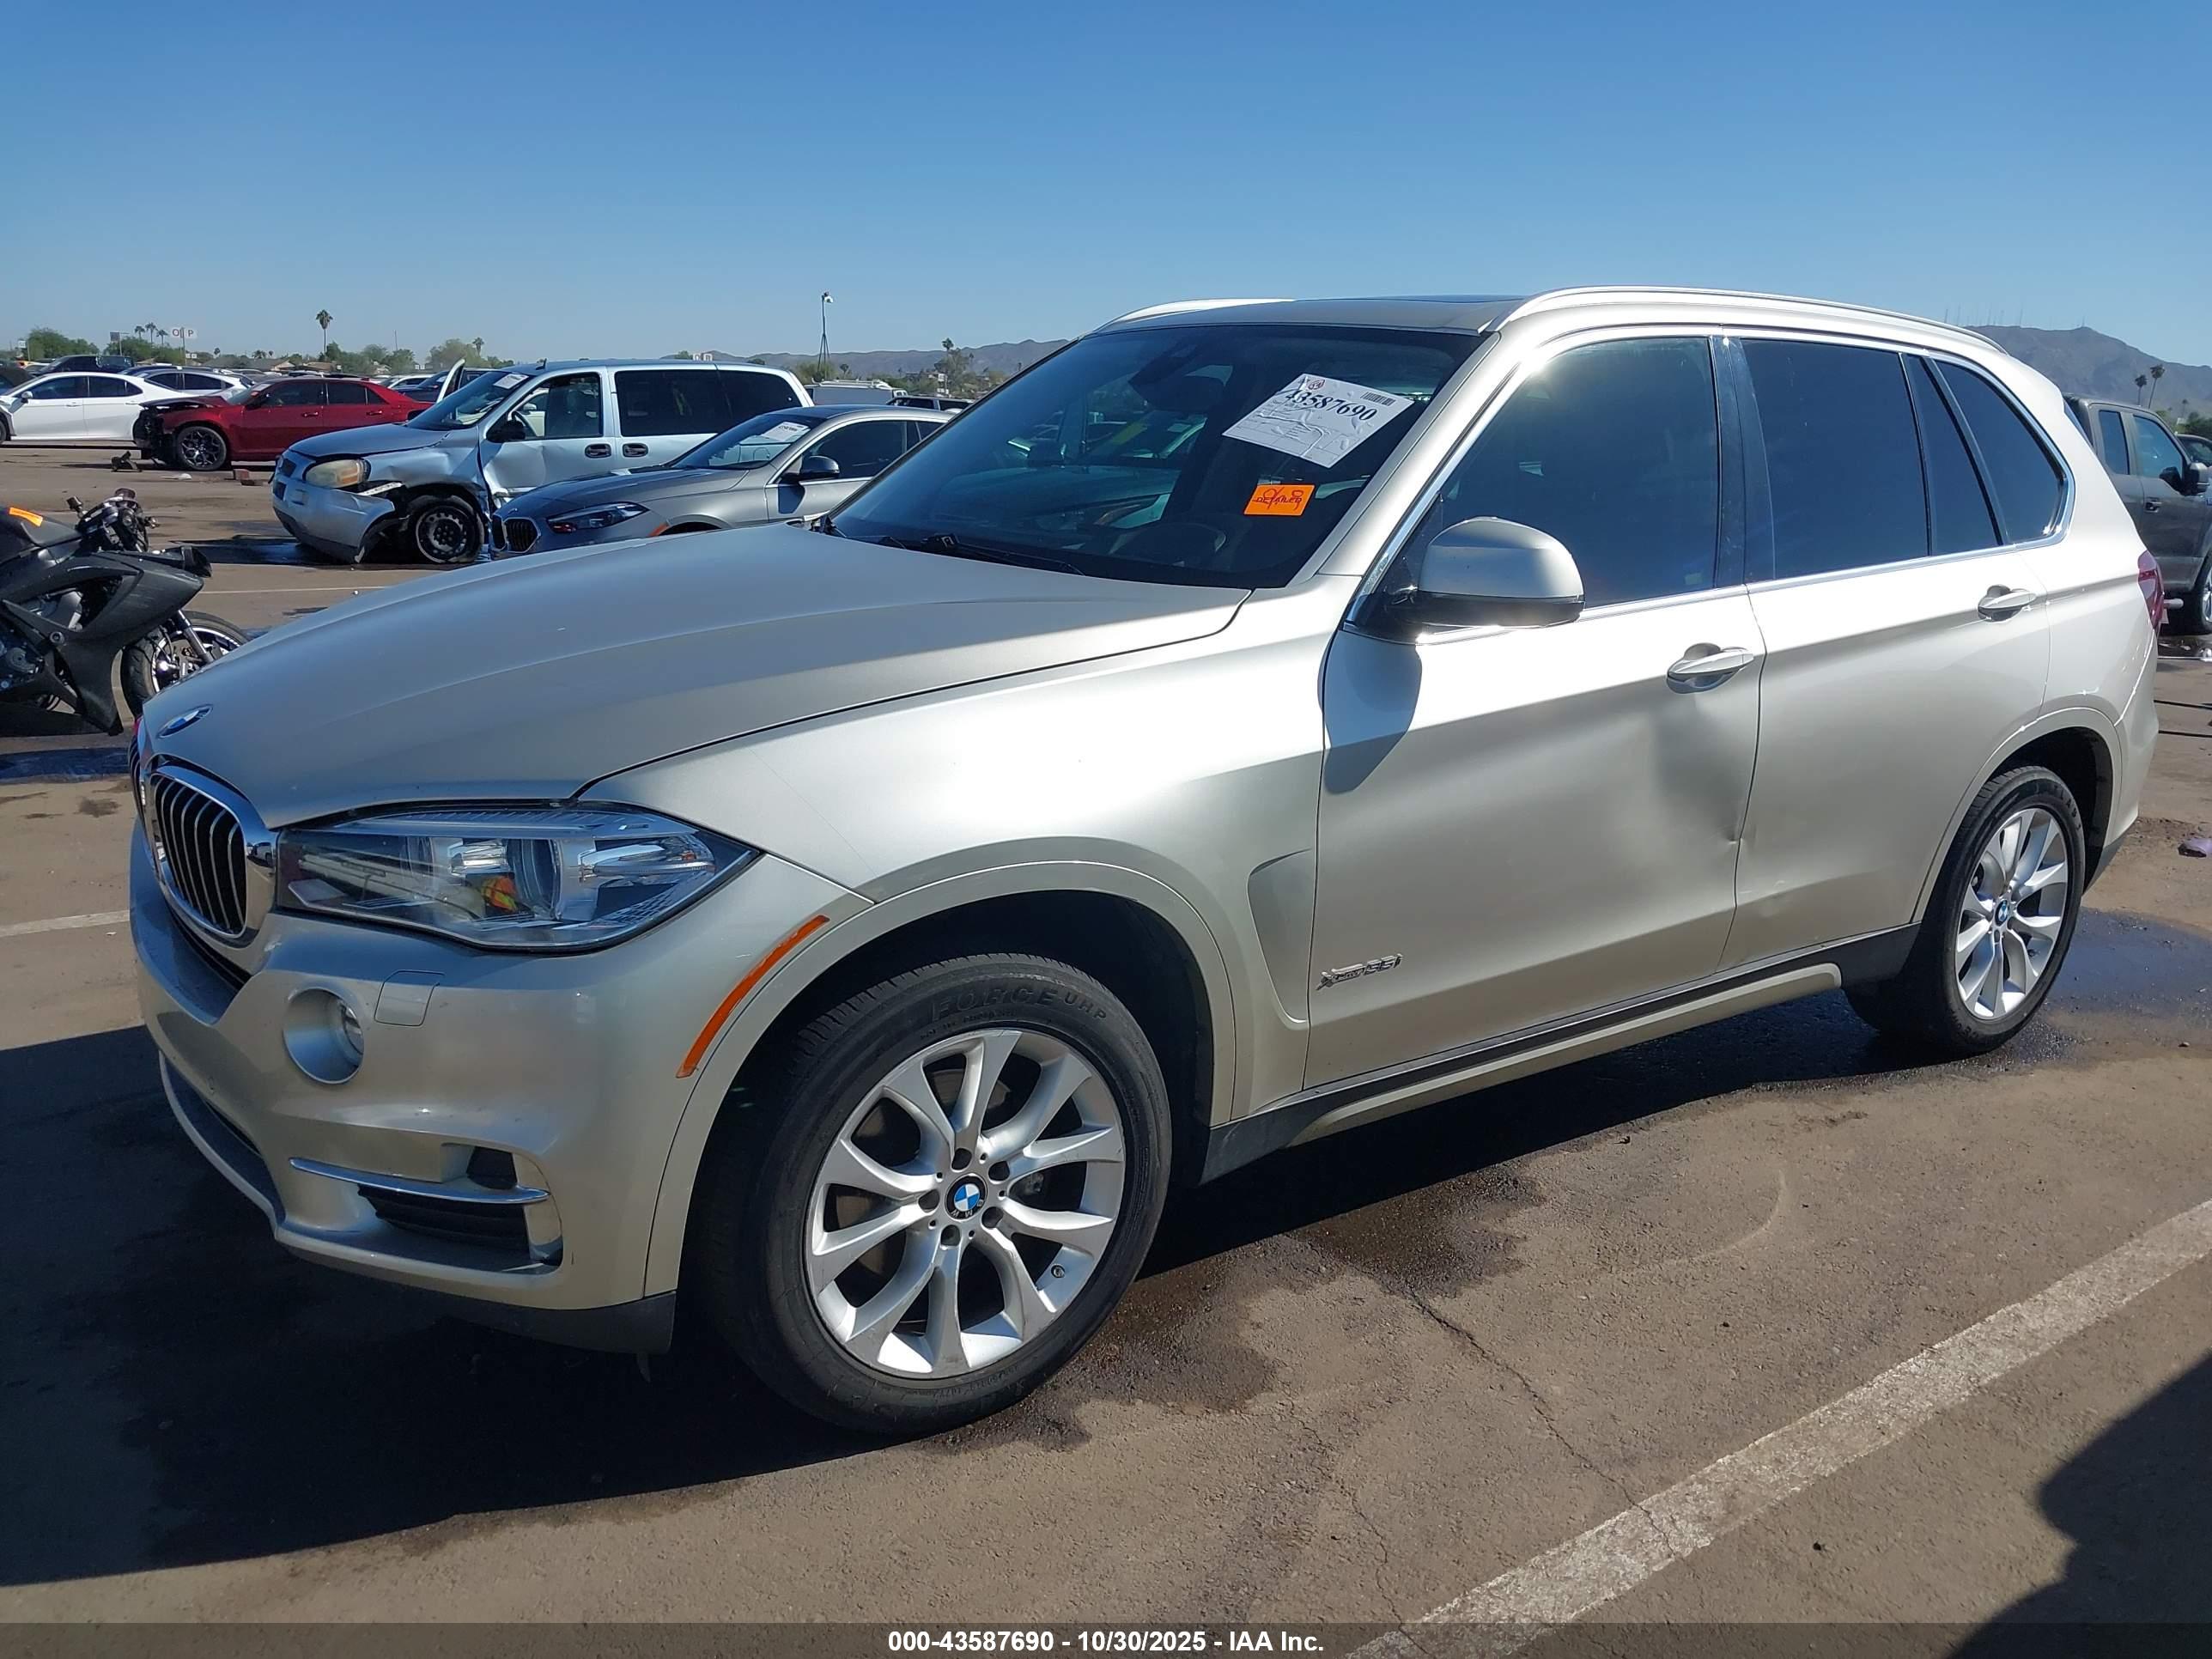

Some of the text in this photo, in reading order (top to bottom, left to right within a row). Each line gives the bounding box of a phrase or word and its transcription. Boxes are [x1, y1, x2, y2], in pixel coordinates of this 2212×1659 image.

[1285, 389, 1377, 421] 43587690
[931, 988, 1108, 1023] FORCE UHP
[951, 1199, 984, 1218] BMW
